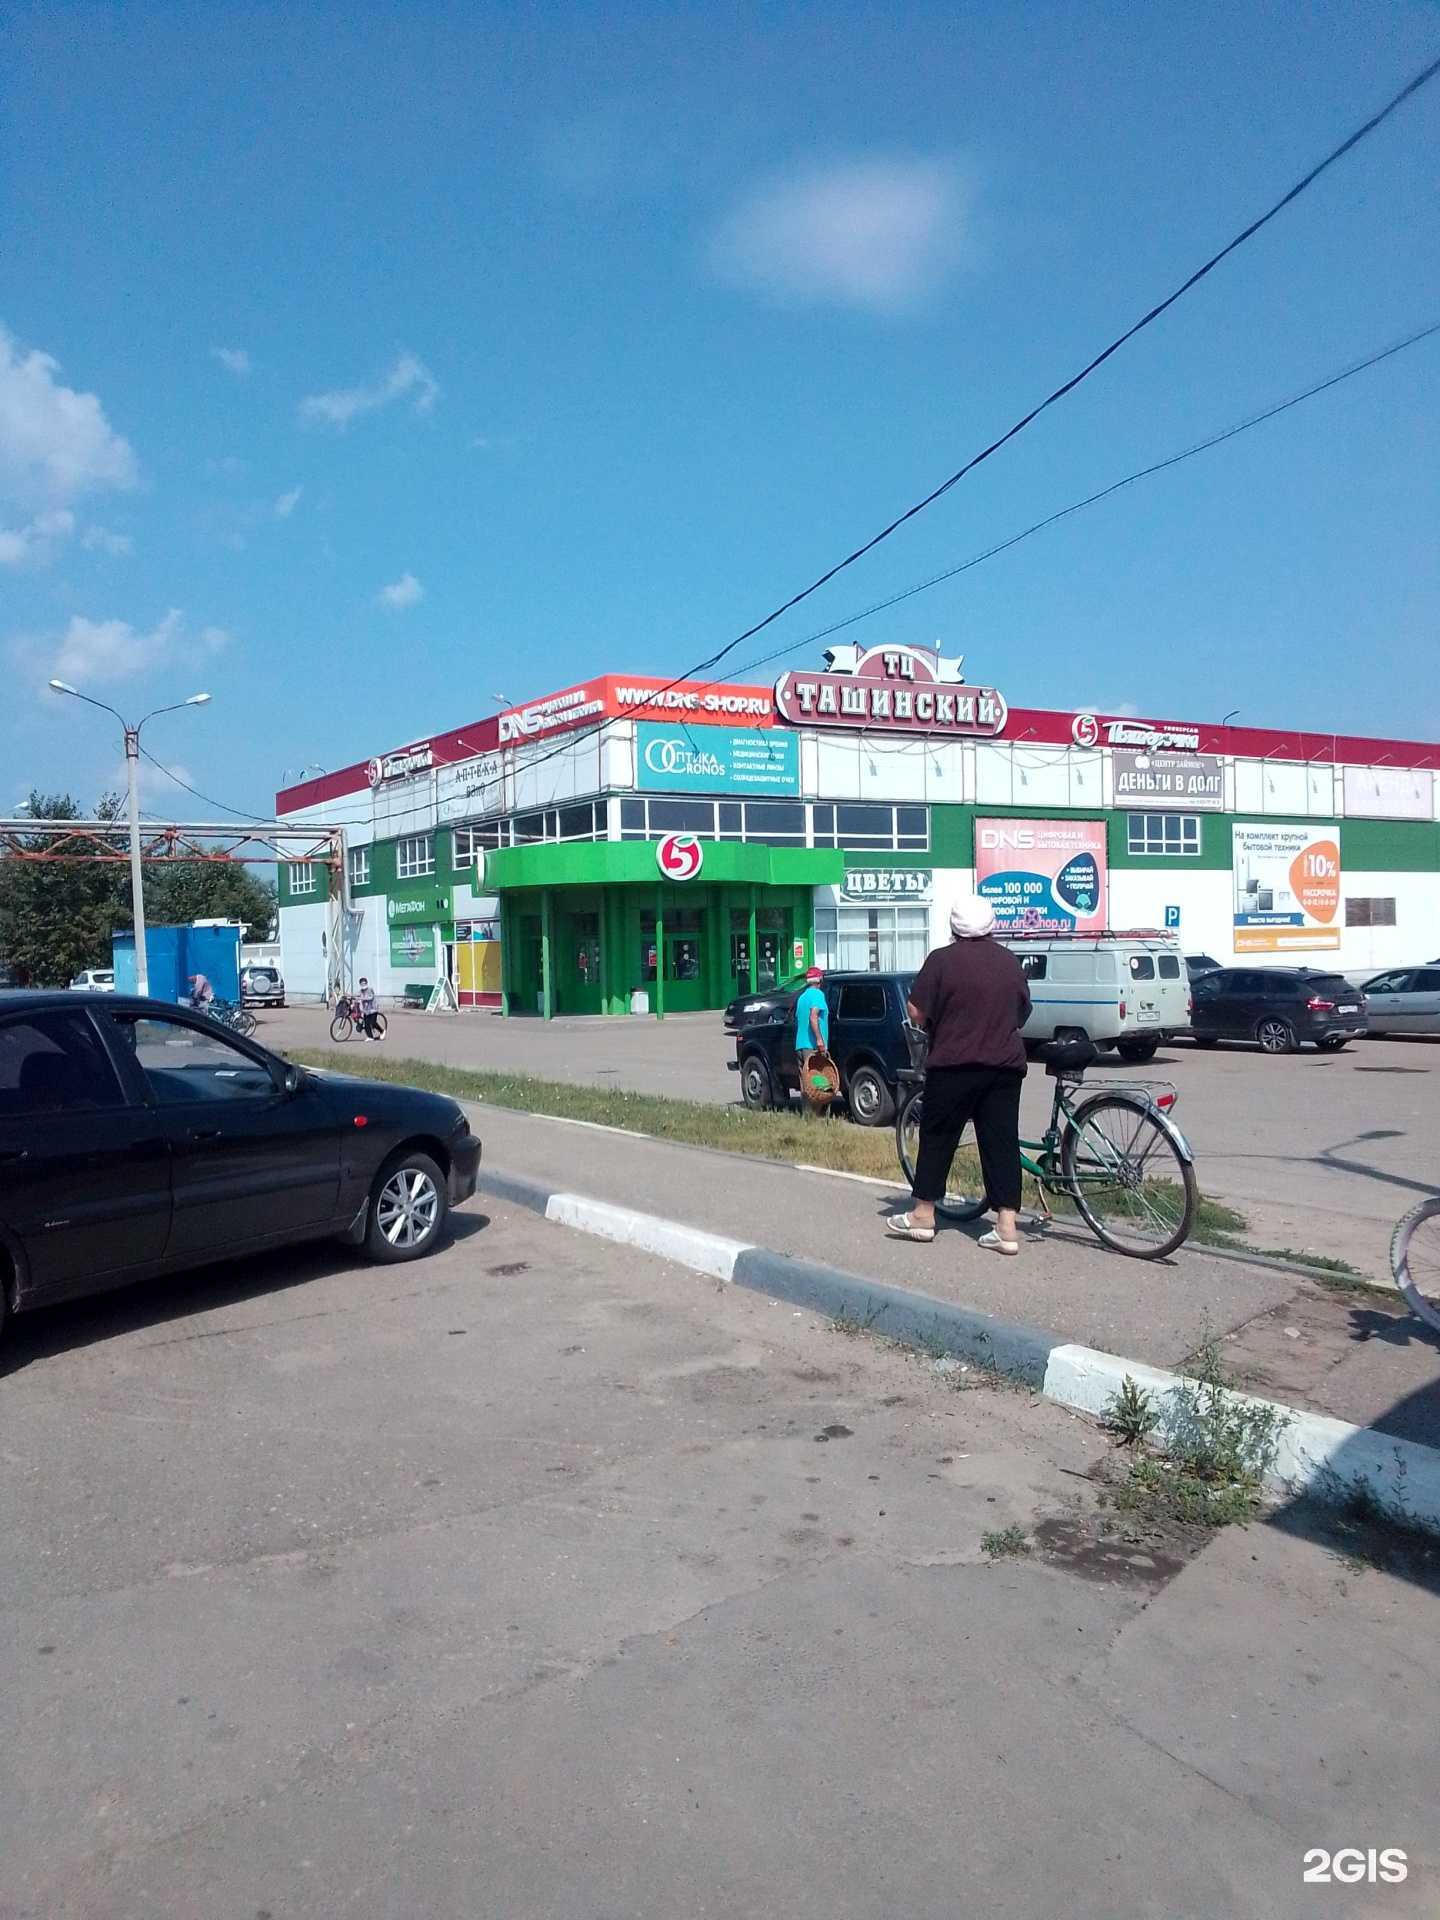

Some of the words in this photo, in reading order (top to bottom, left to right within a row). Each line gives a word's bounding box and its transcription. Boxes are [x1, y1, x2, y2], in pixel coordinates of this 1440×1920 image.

[883, 653, 914, 680] ТЦ
[615, 687, 771, 714] WWW.DNS-SHOP.RU
[797, 683, 996, 724] ТАШИНСКИЙ
[499, 706, 543, 742] DNS
[1118, 772, 1171, 792] ДЕНЬГИ
[1176, 774, 1185, 791] В
[1187, 776, 1221, 794] ДОЛГ
[981, 829, 1035, 849] DNS
[1235, 831, 1244, 840] На
[1308, 854, 1336, 878] 10%
[846, 872, 926, 892] ЦВЕТЫ
[1004, 882, 1021, 894] 100
[1024, 882, 1043, 894] 000
